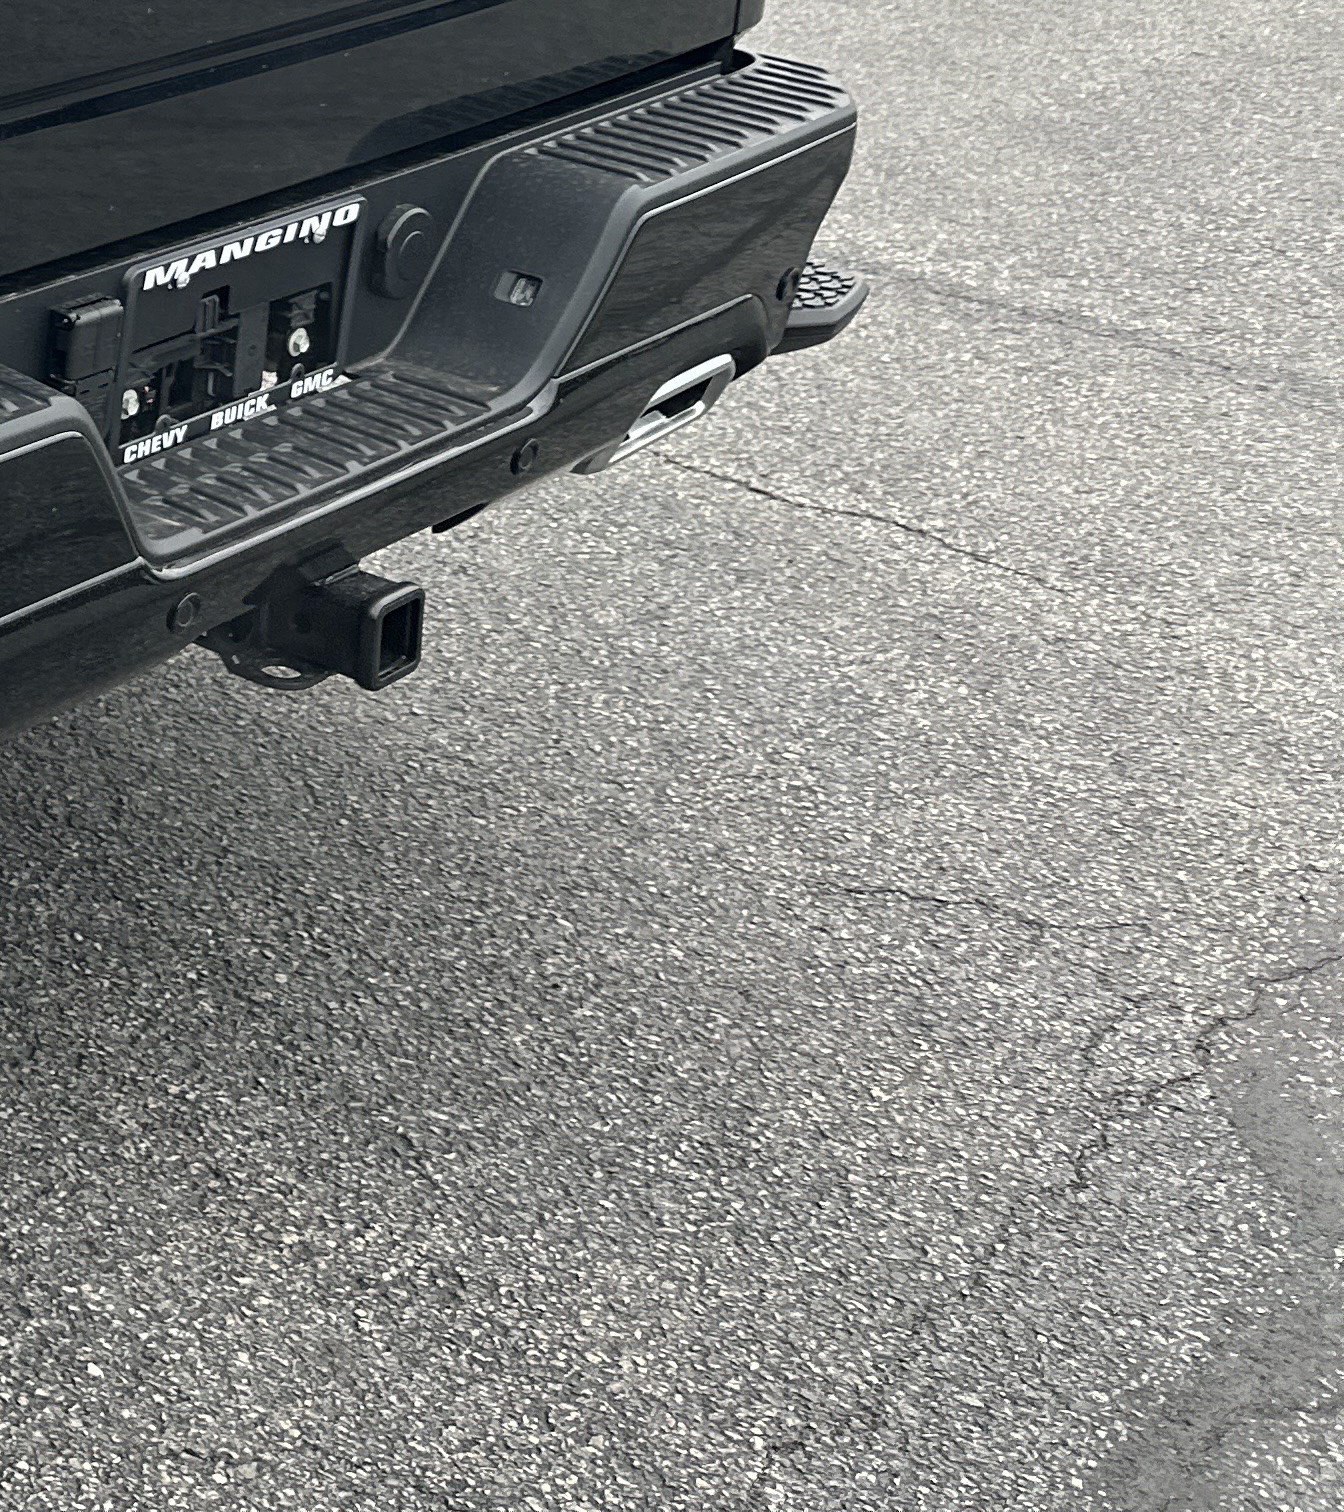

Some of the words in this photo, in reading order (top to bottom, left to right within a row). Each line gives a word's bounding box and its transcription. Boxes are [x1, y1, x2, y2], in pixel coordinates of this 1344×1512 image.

[142, 202, 360, 291] MANGINO
[123, 424, 189, 464] CHEVY
[210, 393, 271, 431] BUICK
[290, 368, 334, 399] GMC
